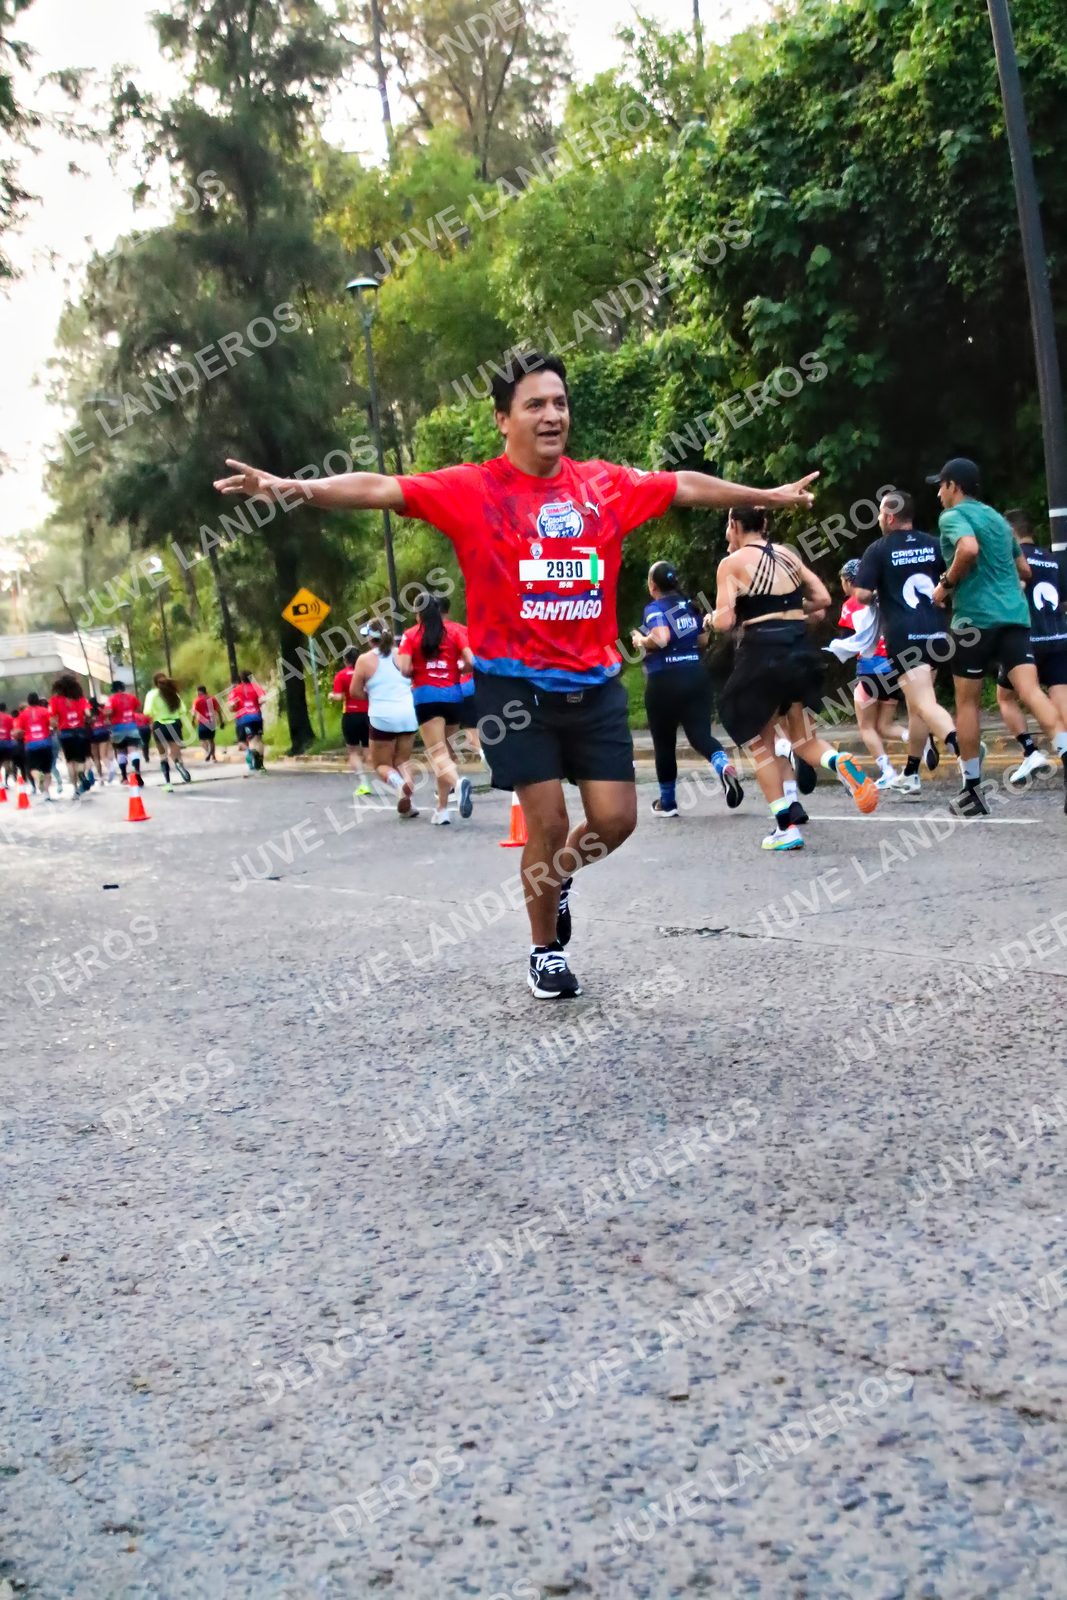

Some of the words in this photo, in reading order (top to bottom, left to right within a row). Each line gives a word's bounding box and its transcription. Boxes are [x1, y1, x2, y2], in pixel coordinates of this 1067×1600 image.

[891, 547, 935, 559] CRISTIAN
[891, 554, 936, 567] VENEGAS
[547, 561, 583, 578] 2930
[519, 599, 602, 621] SANTIAGO
[676, 617, 698, 630] LUISA
